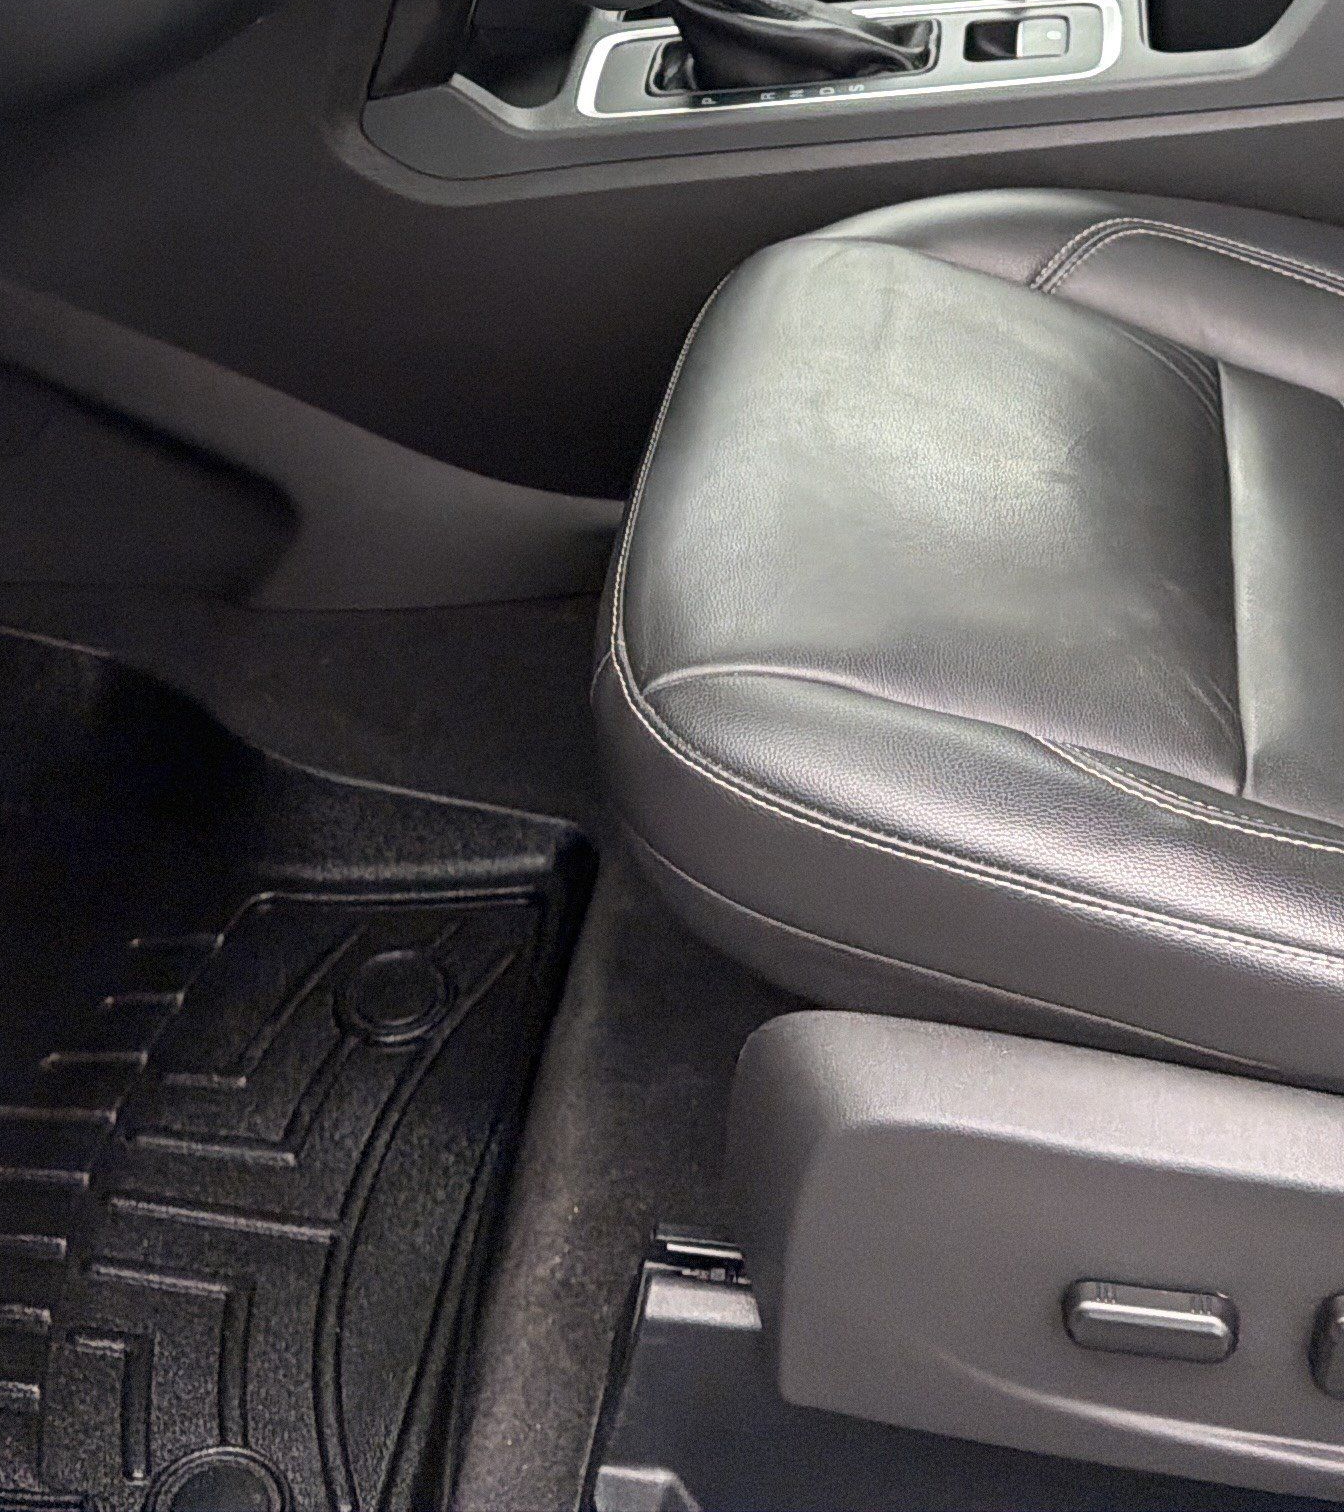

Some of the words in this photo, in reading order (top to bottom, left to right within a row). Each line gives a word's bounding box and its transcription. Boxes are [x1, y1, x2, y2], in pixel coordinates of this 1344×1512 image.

[701, 97, 716, 105] P
[760, 92, 776, 101] R
[848, 84, 864, 93] S
